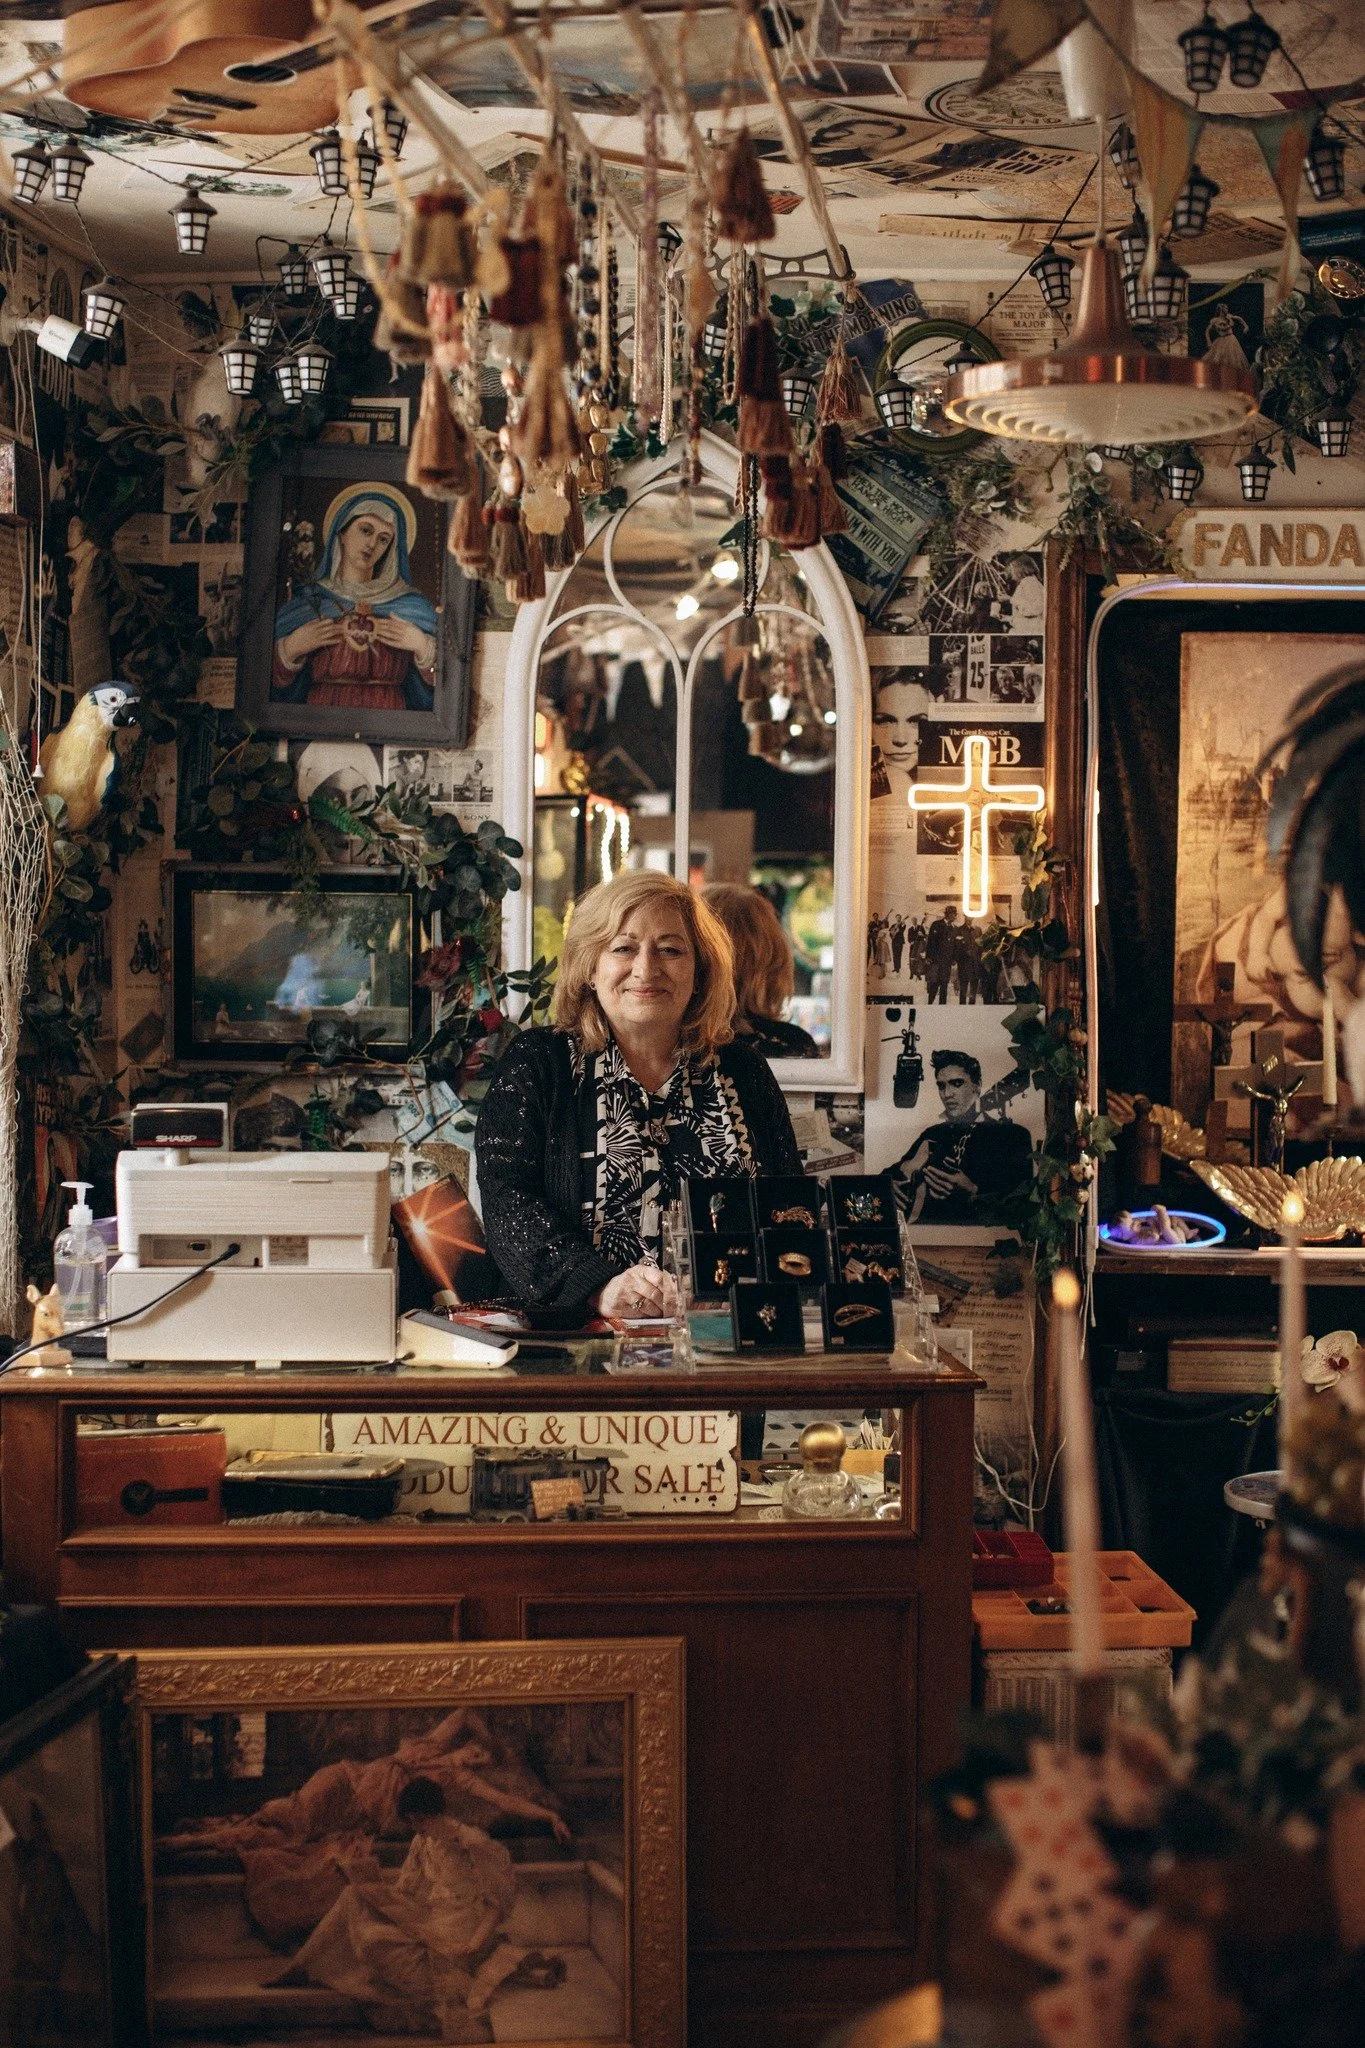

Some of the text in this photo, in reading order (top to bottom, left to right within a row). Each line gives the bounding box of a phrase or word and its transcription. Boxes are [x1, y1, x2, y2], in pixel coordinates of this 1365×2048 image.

[843, 291, 920, 339] MORNING
[850, 479, 905, 525] HANGS HIGH
[873, 488, 890, 503] THE
[889, 501, 916, 524] MOON
[855, 525, 883, 551] WITH
[877, 542, 902, 567] YOU
[1193, 523, 1364, 566] FANDA
[978, 728, 997, 736] Escape
[352, 1415, 720, 1452] AMAZING & UNIQUE
[635, 1464, 726, 1494] SALE
